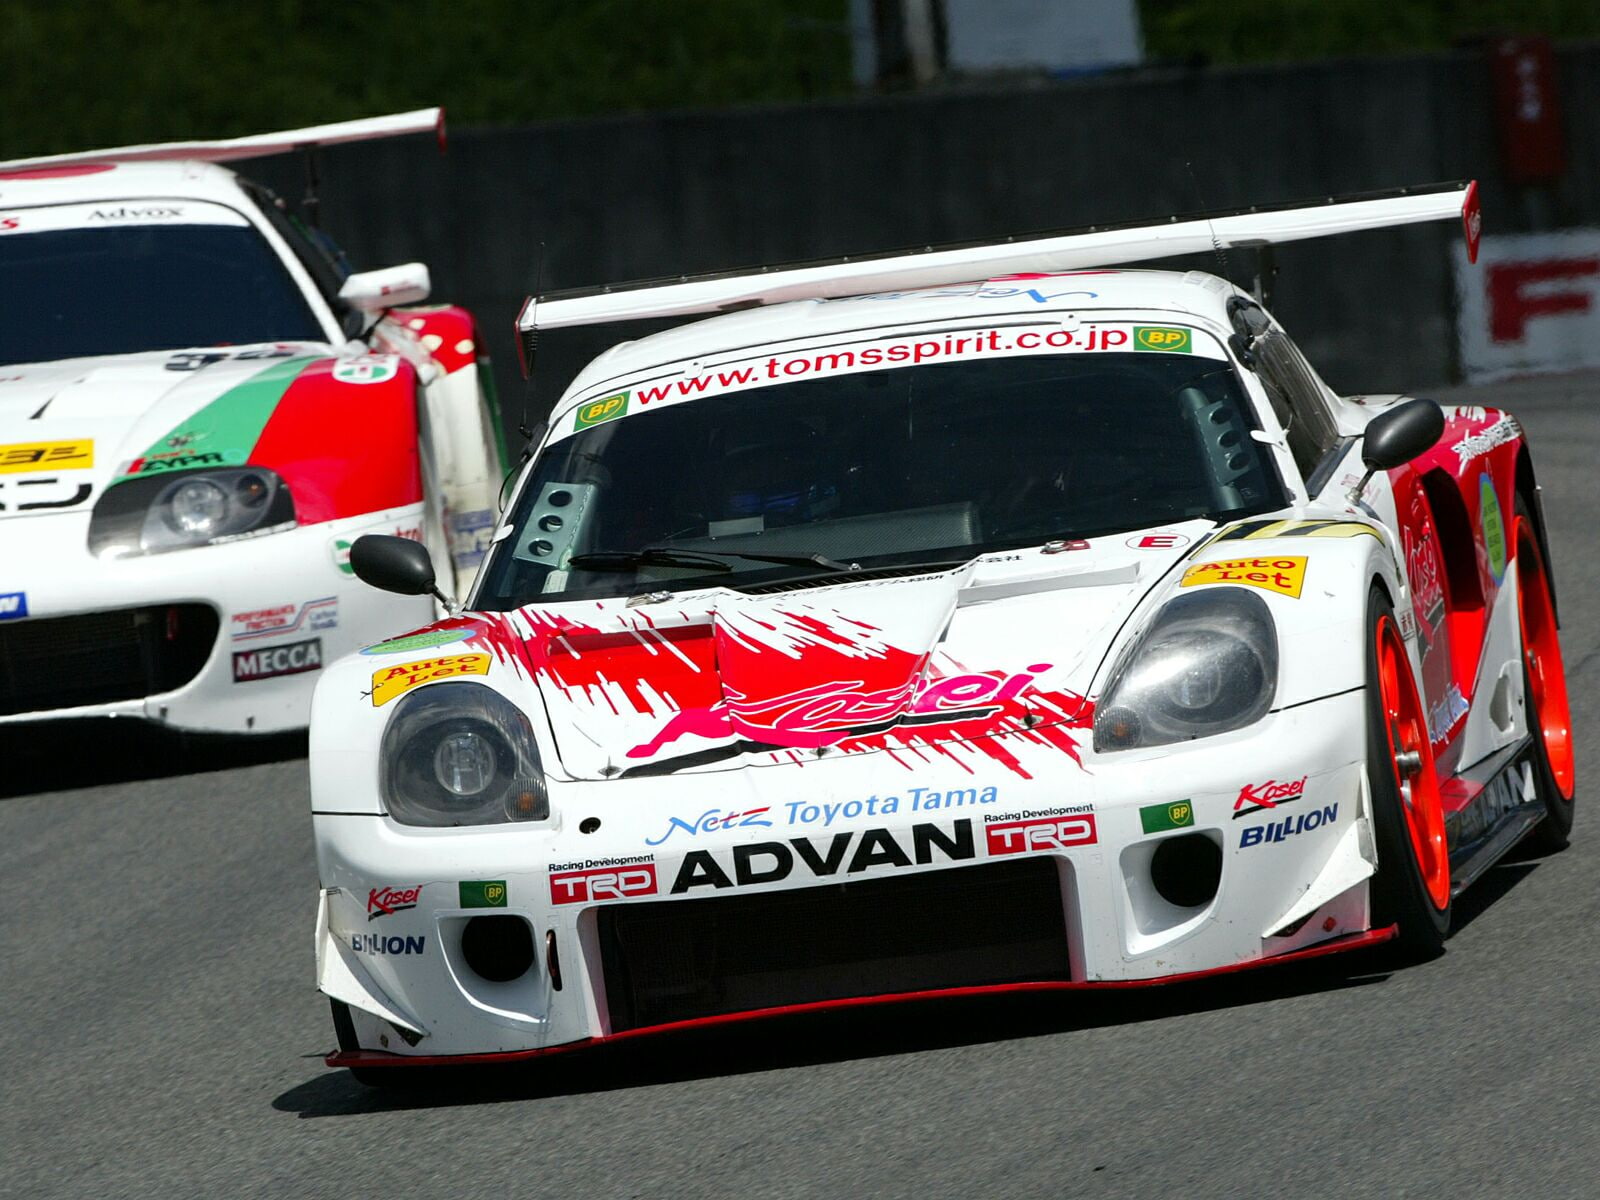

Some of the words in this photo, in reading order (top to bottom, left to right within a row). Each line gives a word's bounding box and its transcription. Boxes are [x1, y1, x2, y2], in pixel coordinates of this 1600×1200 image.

[1147, 331, 1182, 345] BP
[637, 325, 1128, 405] www.tomsspirit.co.jp
[587, 396, 620, 420] BP
[1196, 558, 1297, 573] Auto
[1217, 570, 1293, 589] Let
[235, 642, 321, 677] MECCA
[384, 654, 482, 681] Auto
[404, 663, 478, 687] Let
[1232, 775, 1309, 812] Kosei
[645, 805, 774, 847] Netz
[784, 793, 900, 827] Toyota
[907, 786, 999, 812] Tama
[984, 810, 1021, 824] Racing
[1022, 803, 1094, 819] Development
[1238, 802, 1339, 849] BILLION
[989, 818, 1093, 853] TRD
[548, 859, 584, 873] Racing
[585, 853, 655, 870] Development
[668, 817, 977, 896] ADVAN
[367, 884, 423, 915] Kosei
[553, 869, 652, 902] TRD
[351, 933, 426, 956] BILLION
